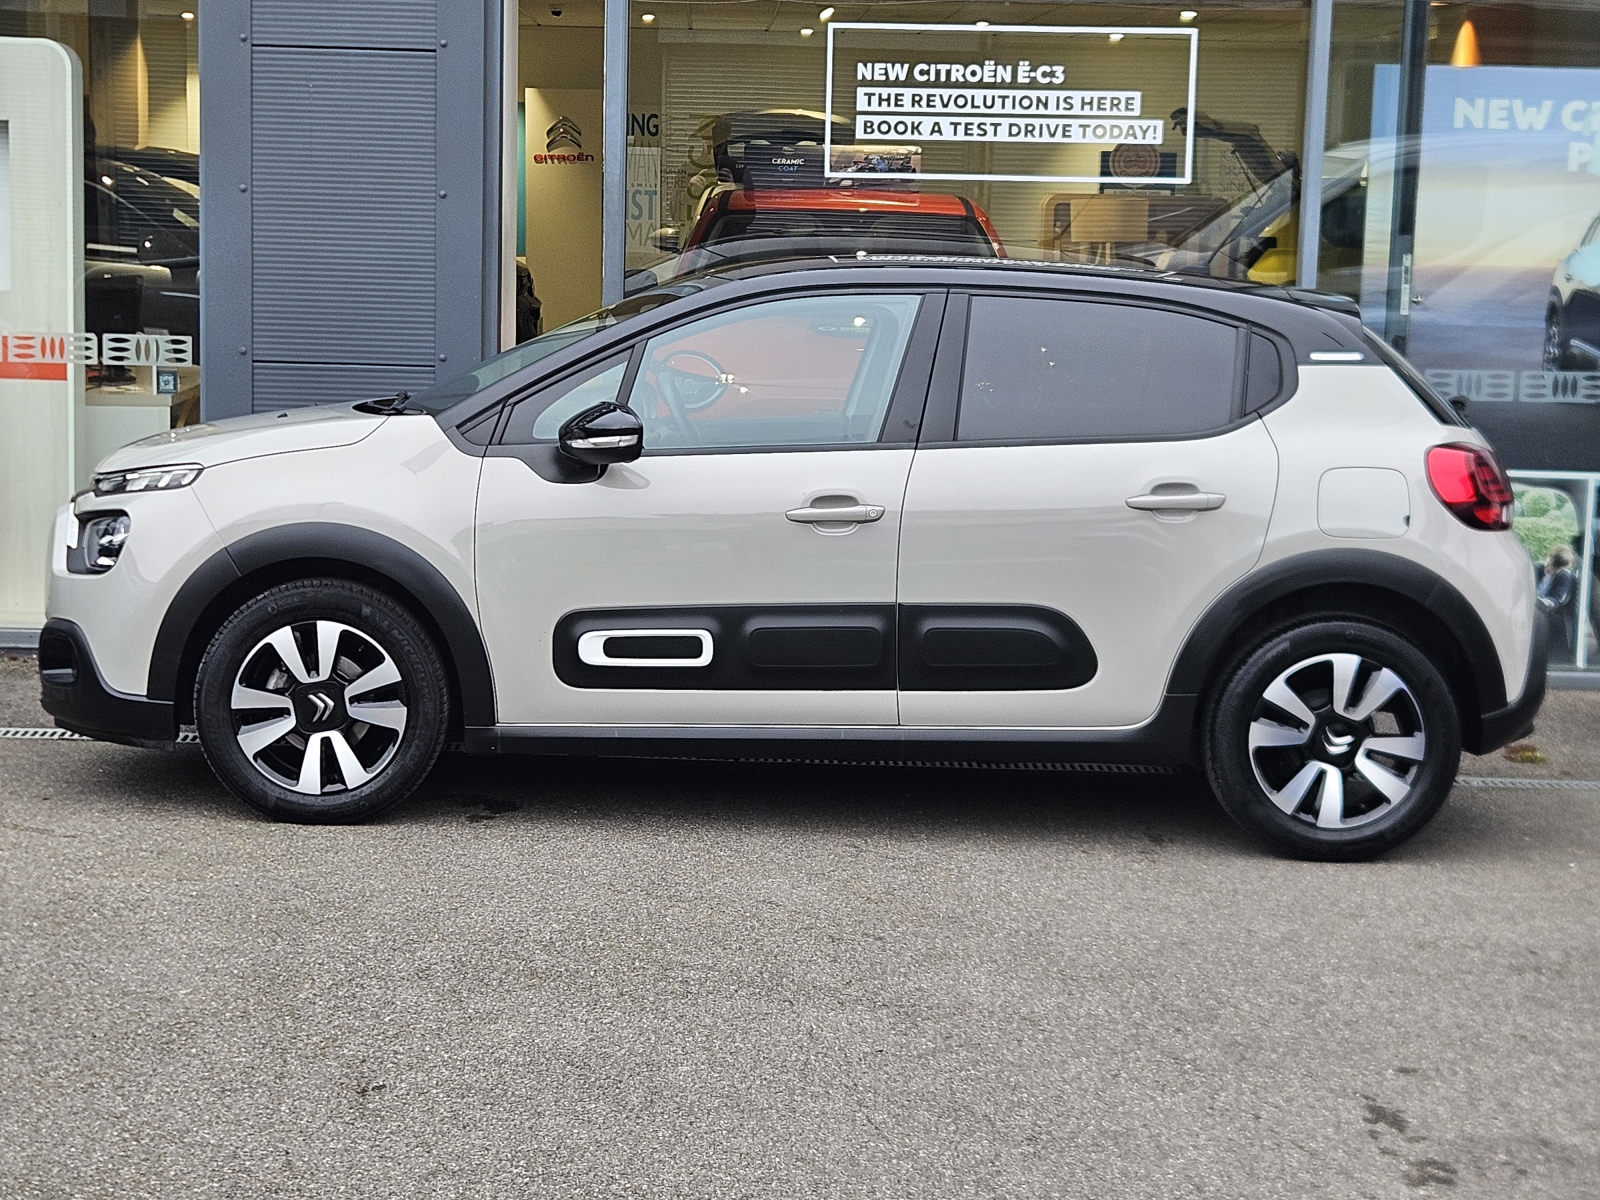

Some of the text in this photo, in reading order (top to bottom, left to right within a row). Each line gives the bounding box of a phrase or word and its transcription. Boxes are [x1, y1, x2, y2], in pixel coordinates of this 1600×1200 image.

[857, 60, 1065, 84] NEW CITROËN Ë-C3
[863, 92, 1136, 112] THE REVOLUTION IS HERE
[1453, 97, 1553, 131] NEW
[863, 120, 1158, 141] BOOK A TEST DRIVE TODAY!
[771, 158, 805, 166] CERAMIC
